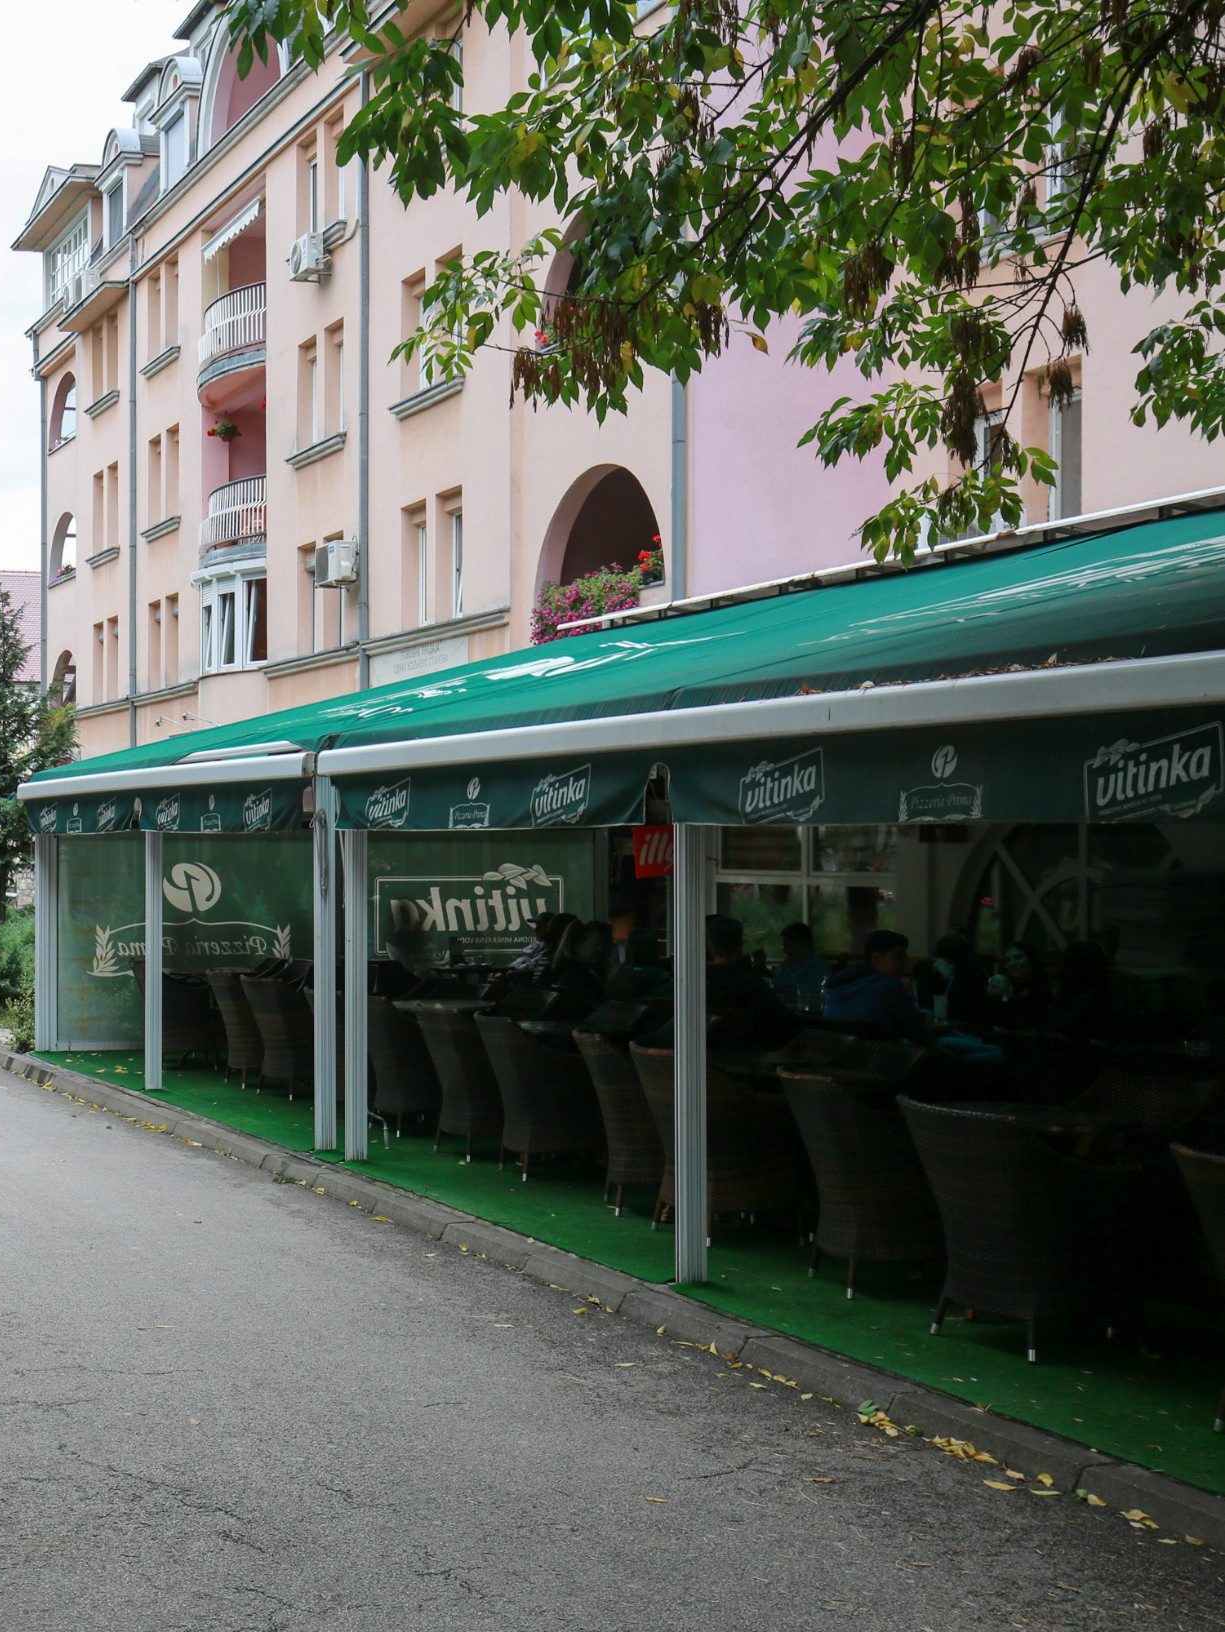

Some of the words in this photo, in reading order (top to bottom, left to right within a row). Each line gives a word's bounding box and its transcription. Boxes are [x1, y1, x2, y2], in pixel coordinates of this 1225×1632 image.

[745, 764, 816, 813] vitinka
[1096, 743, 1212, 806] vitinka
[368, 788, 407, 820] vitinka
[535, 777, 586, 817] vitinka
